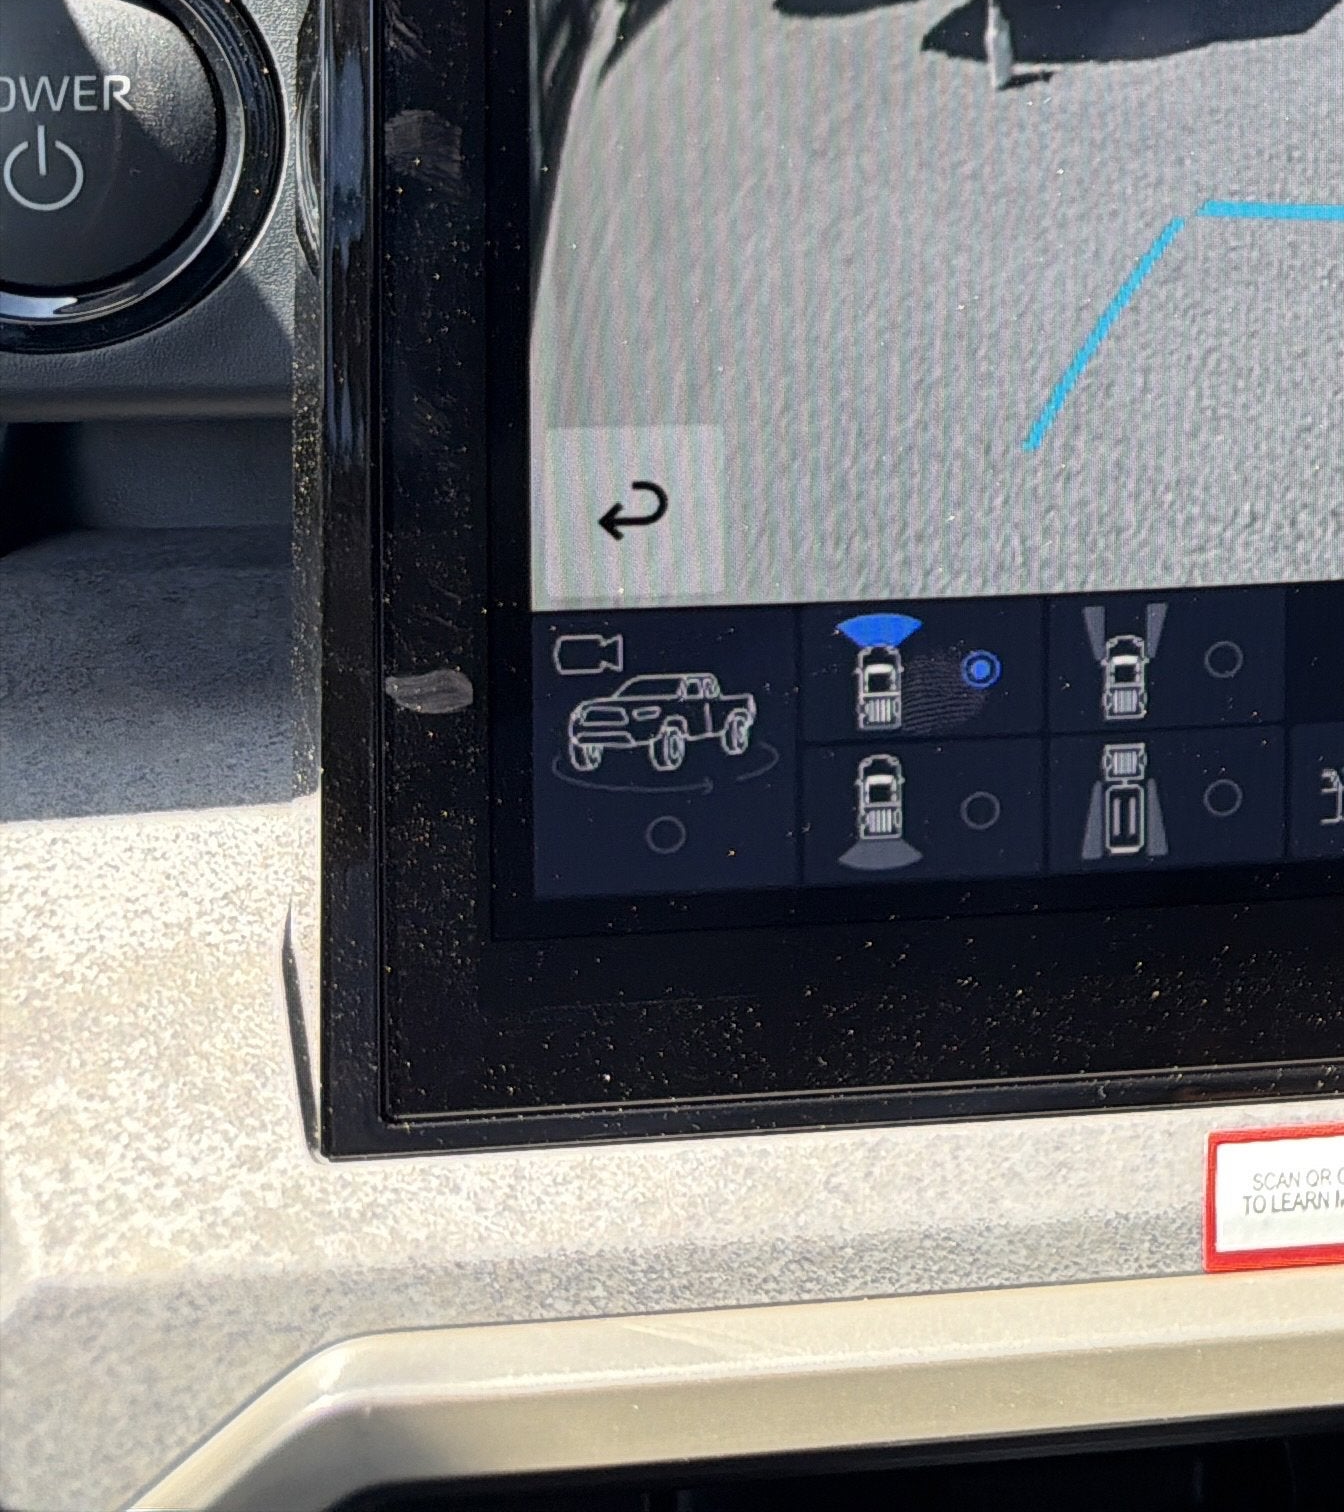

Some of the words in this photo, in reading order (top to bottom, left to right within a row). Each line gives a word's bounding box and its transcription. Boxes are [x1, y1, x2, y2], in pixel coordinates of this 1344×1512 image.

[1252, 1171, 1301, 1192] SCAN
[1242, 1194, 1267, 1216] TO
[1271, 1190, 1330, 1213] LEARN
